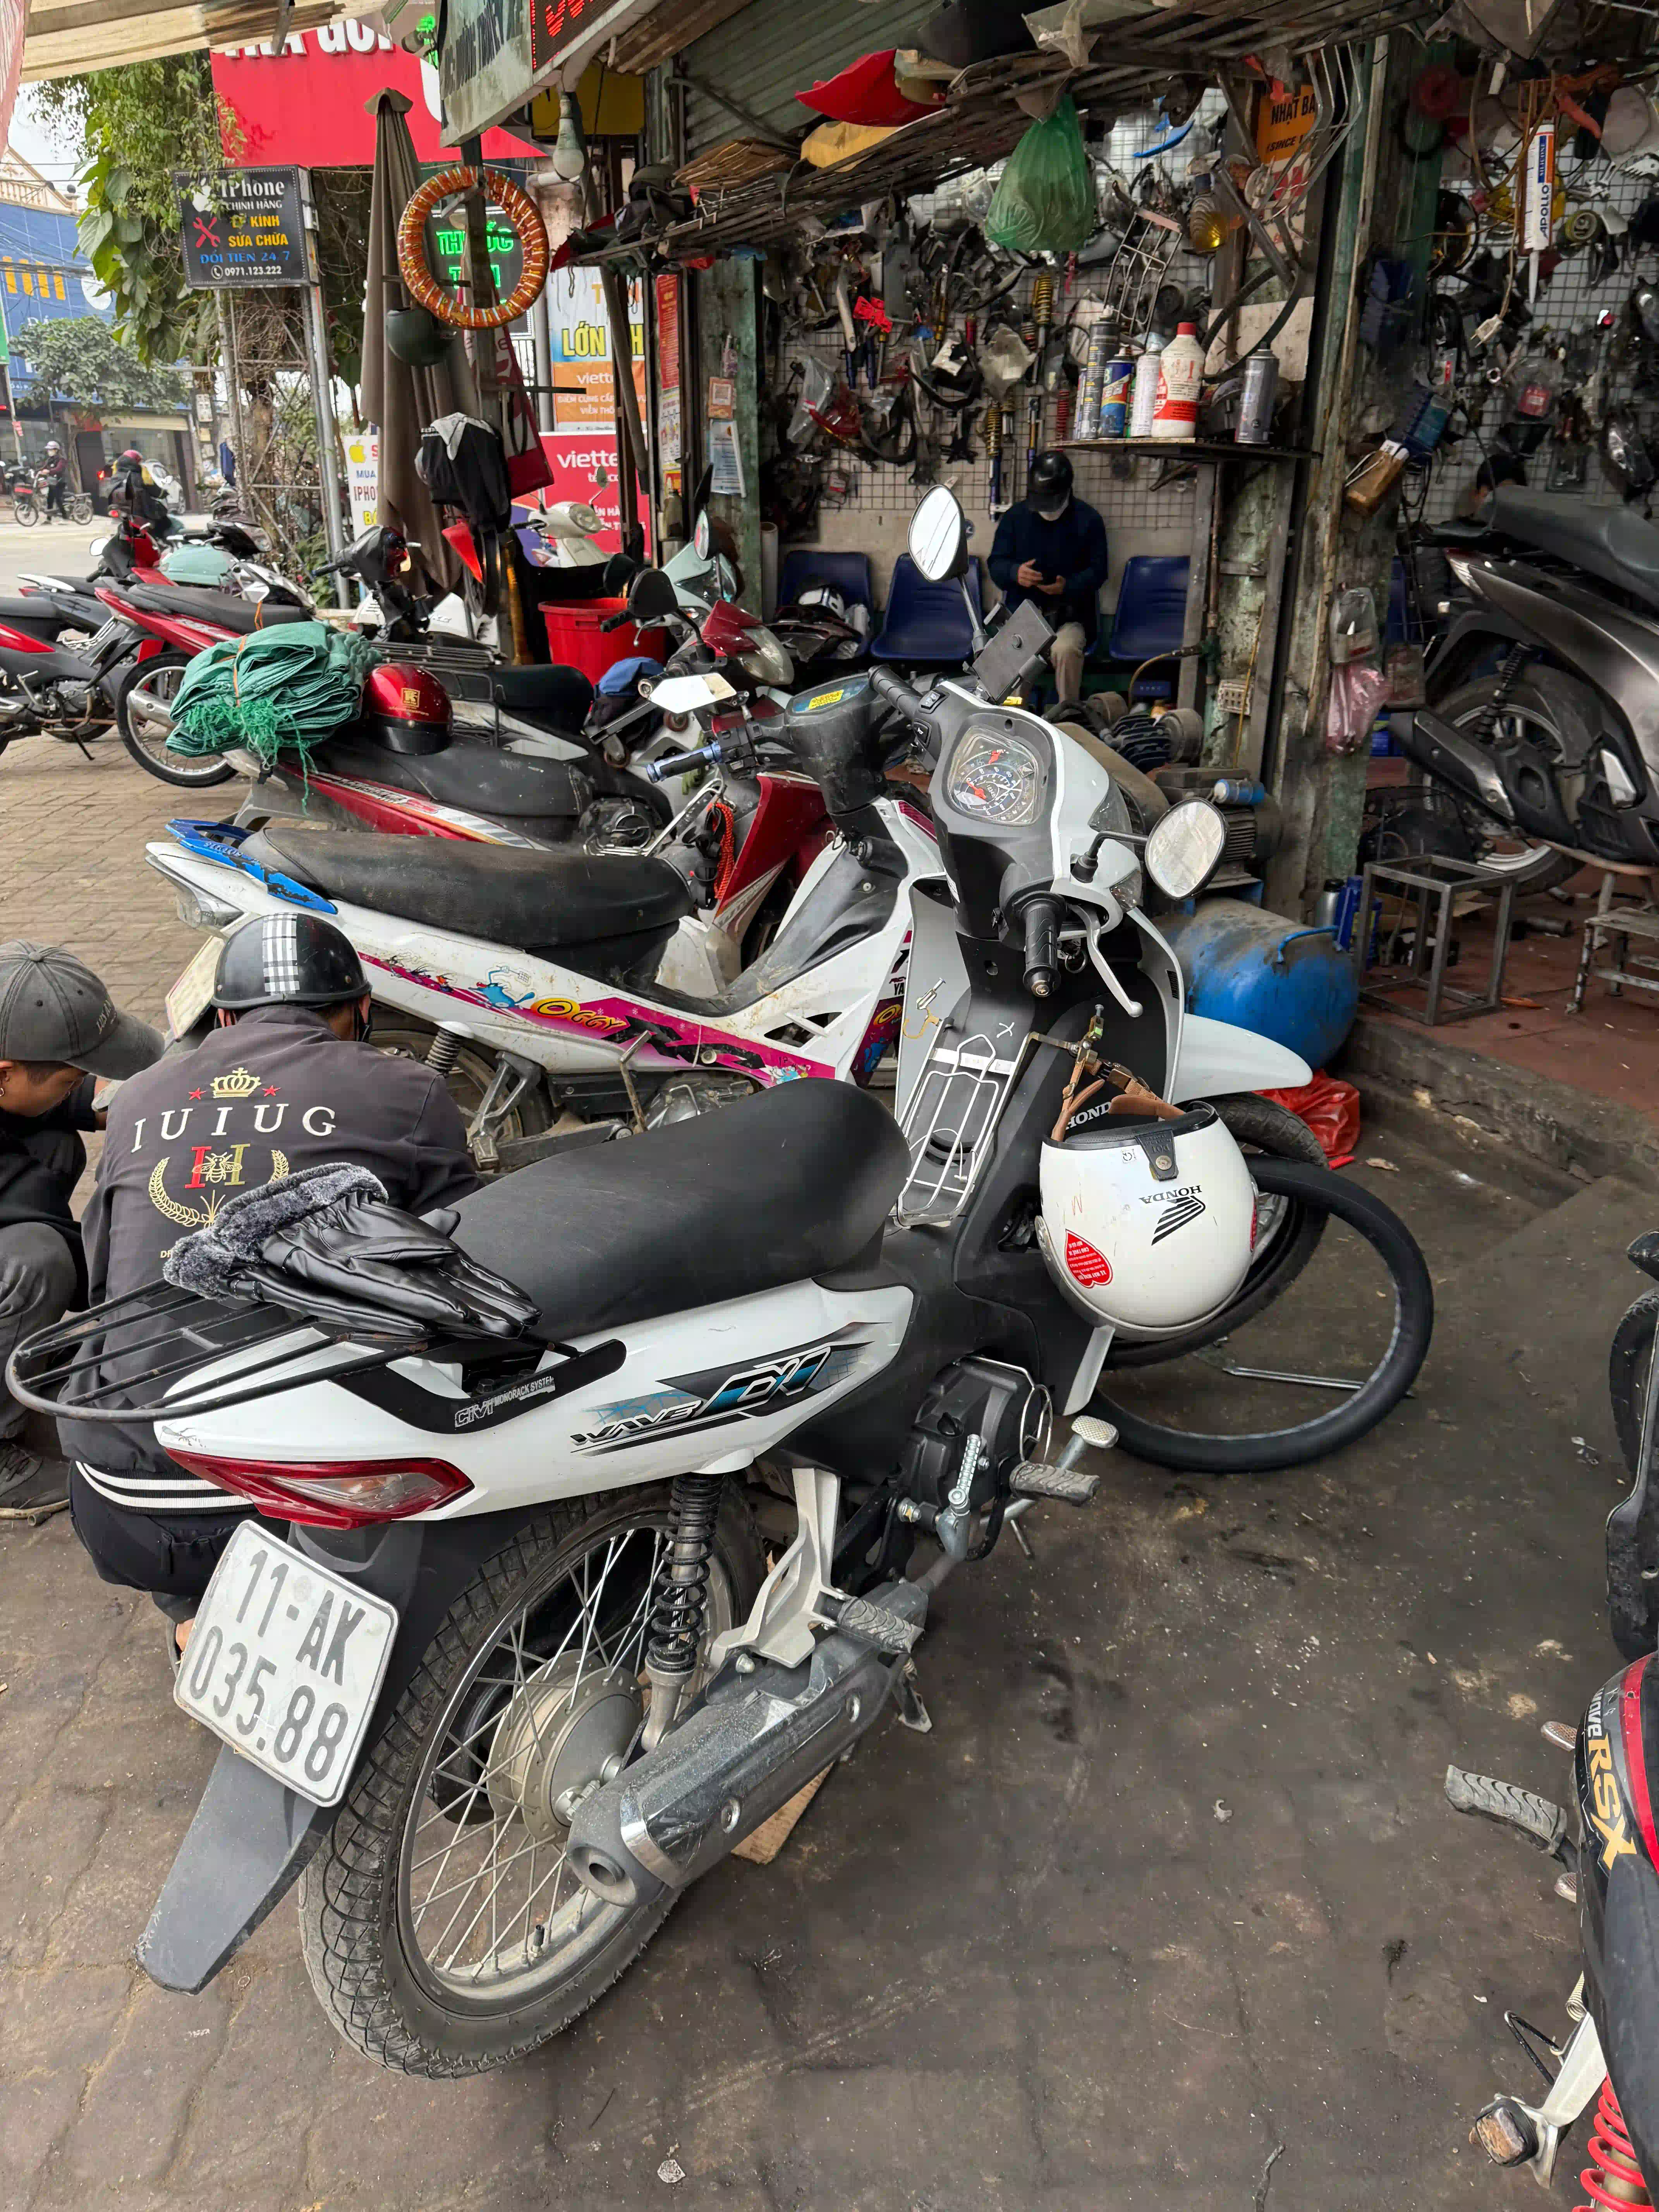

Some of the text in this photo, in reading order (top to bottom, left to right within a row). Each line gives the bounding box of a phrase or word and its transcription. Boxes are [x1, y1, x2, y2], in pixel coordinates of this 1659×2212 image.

[1540, 185, 1549, 240] APOLLO
[228, 230, 253, 247] SỬA
[224, 265, 282, 276] 0971.123.222
[562, 320, 605, 357] LỚN
[576, 372, 613, 384] viett
[556, 450, 618, 468] viette
[356, 469, 376, 478] MUA
[353, 486, 377, 501] IPHO
[537, 999, 626, 1030] OGGY
[1065, 1101, 1112, 1130] HOND
[1139, 1185, 1202, 1204] HONDA
[493, 1384, 530, 1407] MONORACK
[235, 1549, 366, 1687] 11-AK
[189, 1625, 349, 1783] 035.88
[1588, 1732, 1637, 1870] RSX
